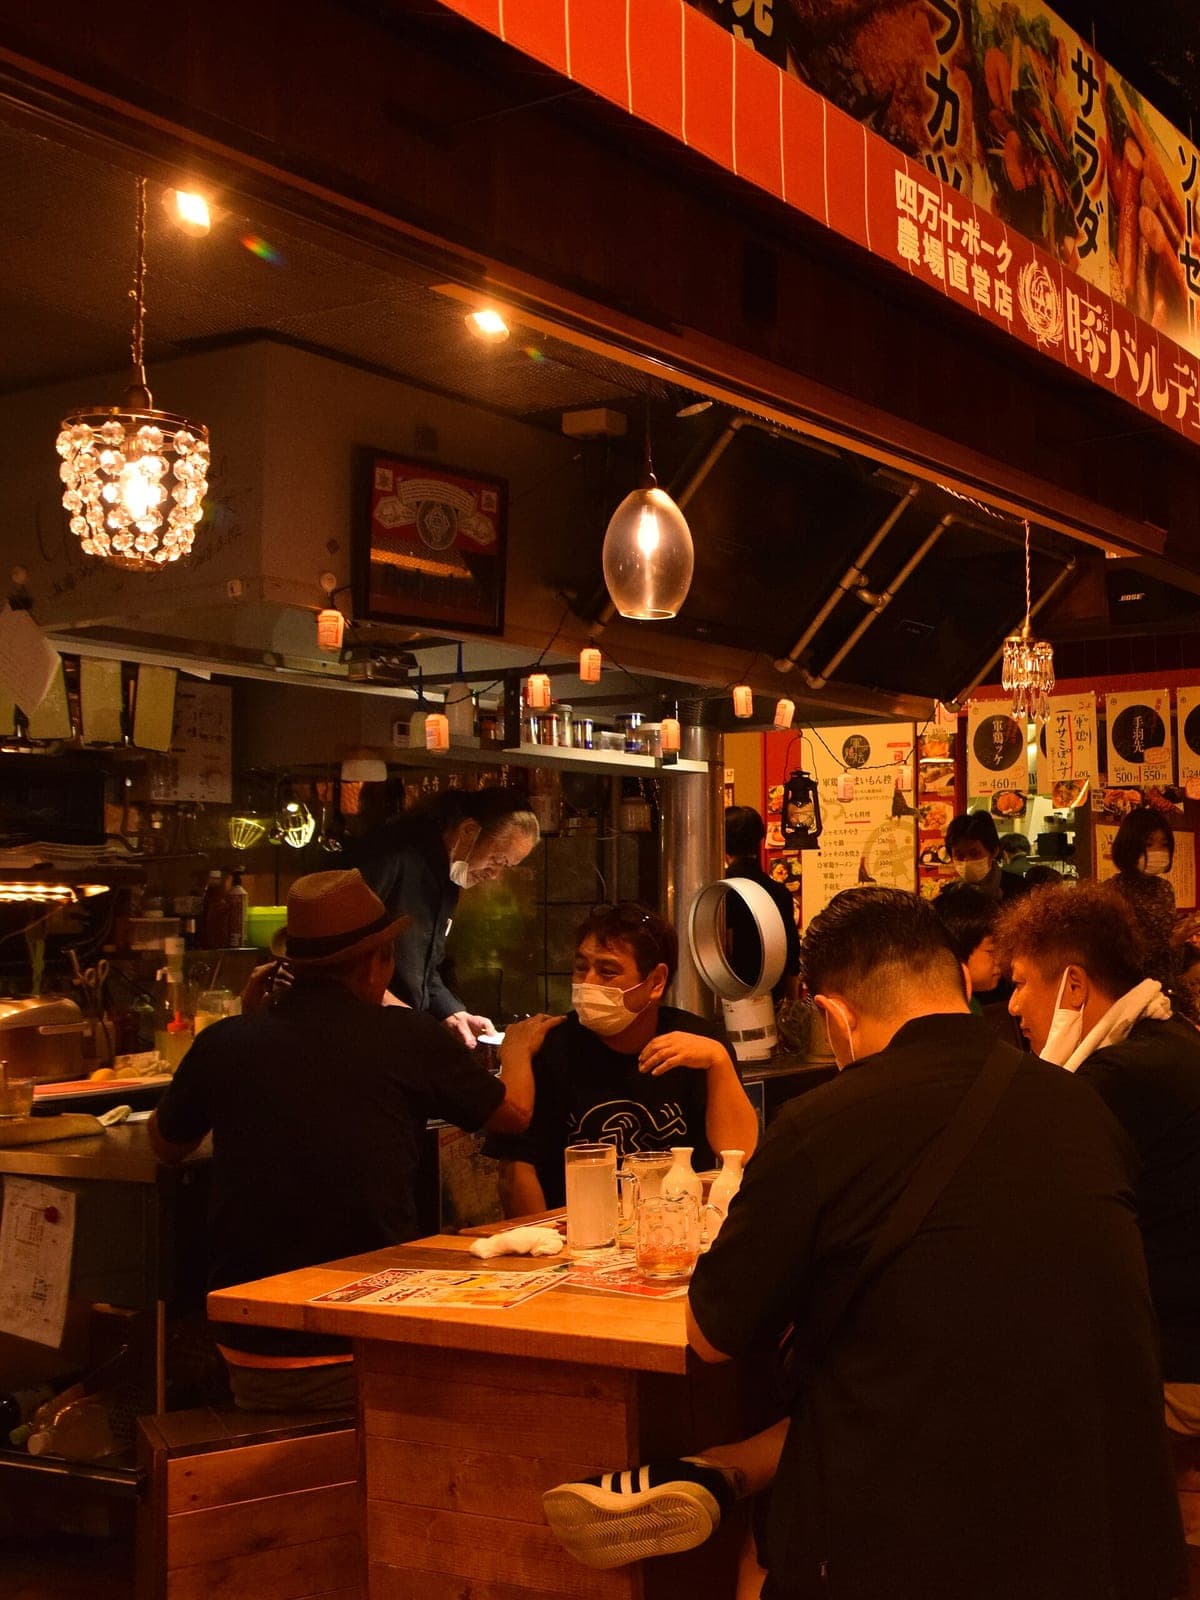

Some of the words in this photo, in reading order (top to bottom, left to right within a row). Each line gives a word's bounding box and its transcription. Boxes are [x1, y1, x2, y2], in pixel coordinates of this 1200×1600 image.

[1071, 47, 1103, 259] サラダ
[894, 169, 1013, 273] 四万十ポーク
[896, 217, 1013, 322] 農場直営店
[1116, 772, 1138, 783] 500円
[1143, 770, 1167, 781] 550円
[1133, 715, 1145, 753] 手羽先
